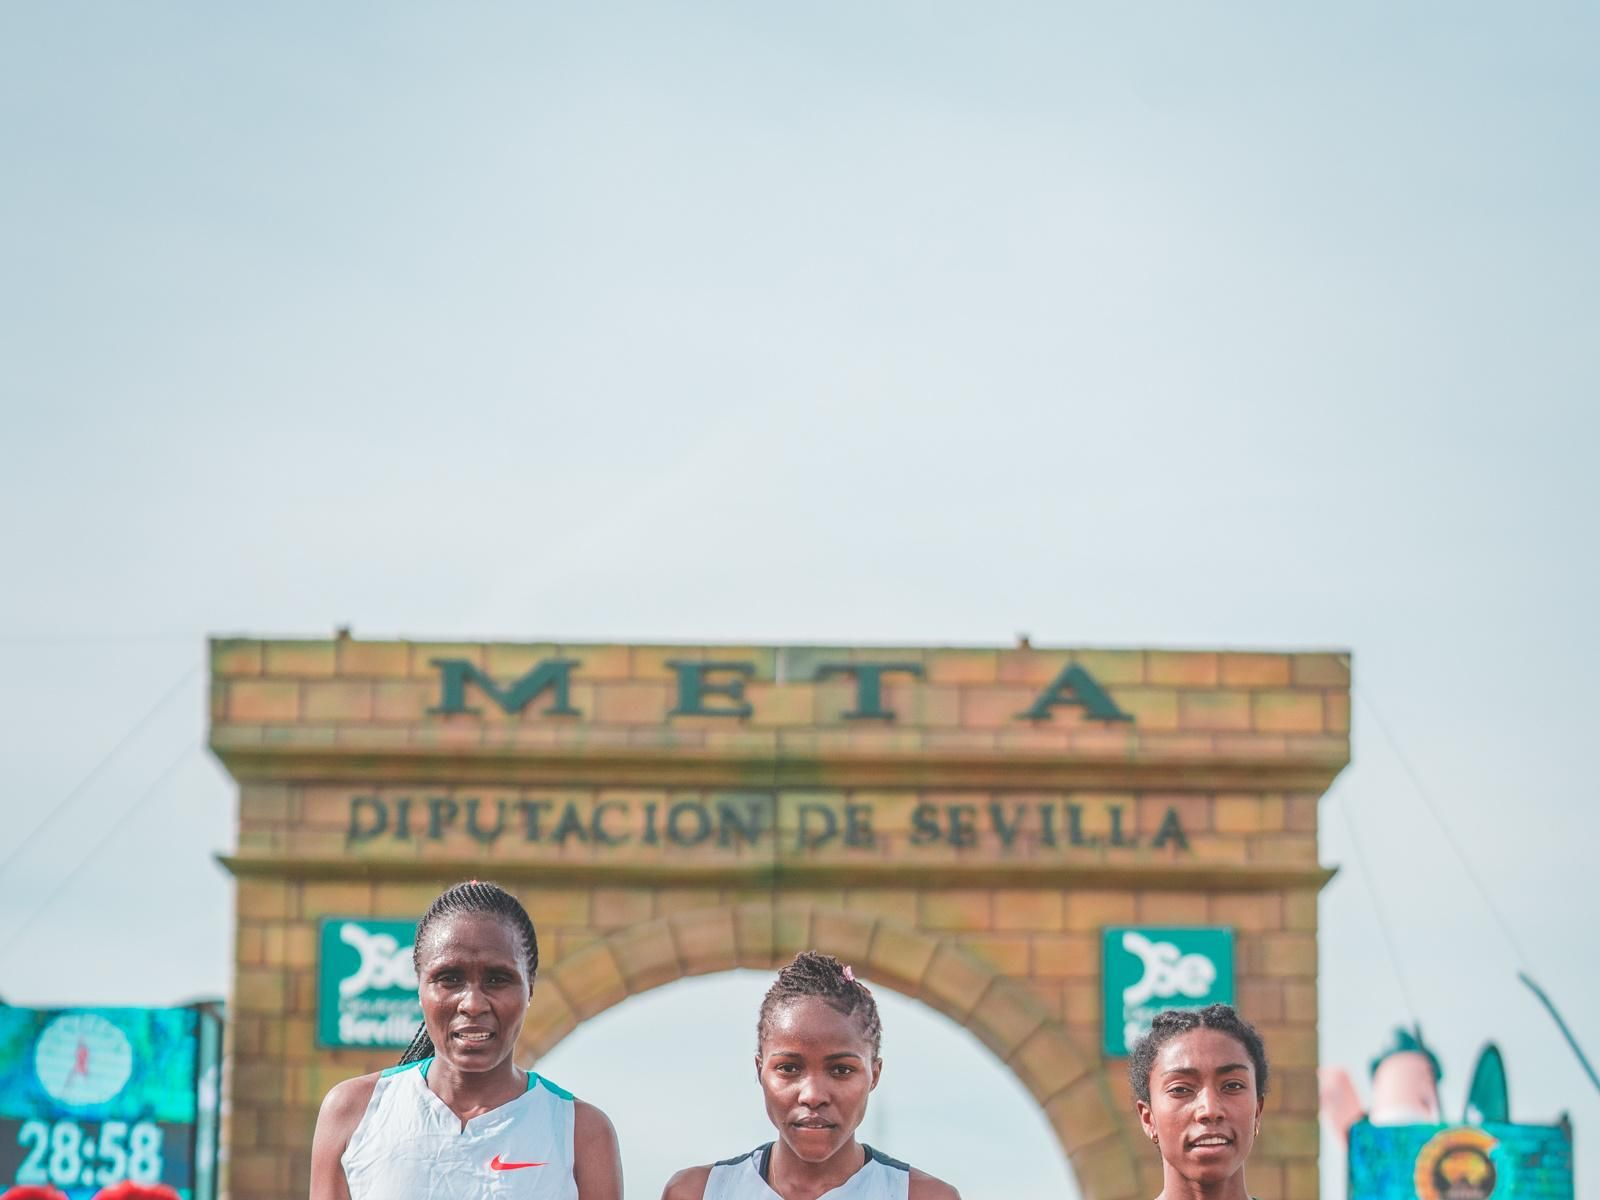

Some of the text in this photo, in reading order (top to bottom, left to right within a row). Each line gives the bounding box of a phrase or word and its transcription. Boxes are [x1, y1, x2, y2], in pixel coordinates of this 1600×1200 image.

[426, 659, 1135, 722] META
[347, 797, 1191, 851] DIPUTACION DE SEVILLA
[14, 1119, 164, 1187] 28:58
